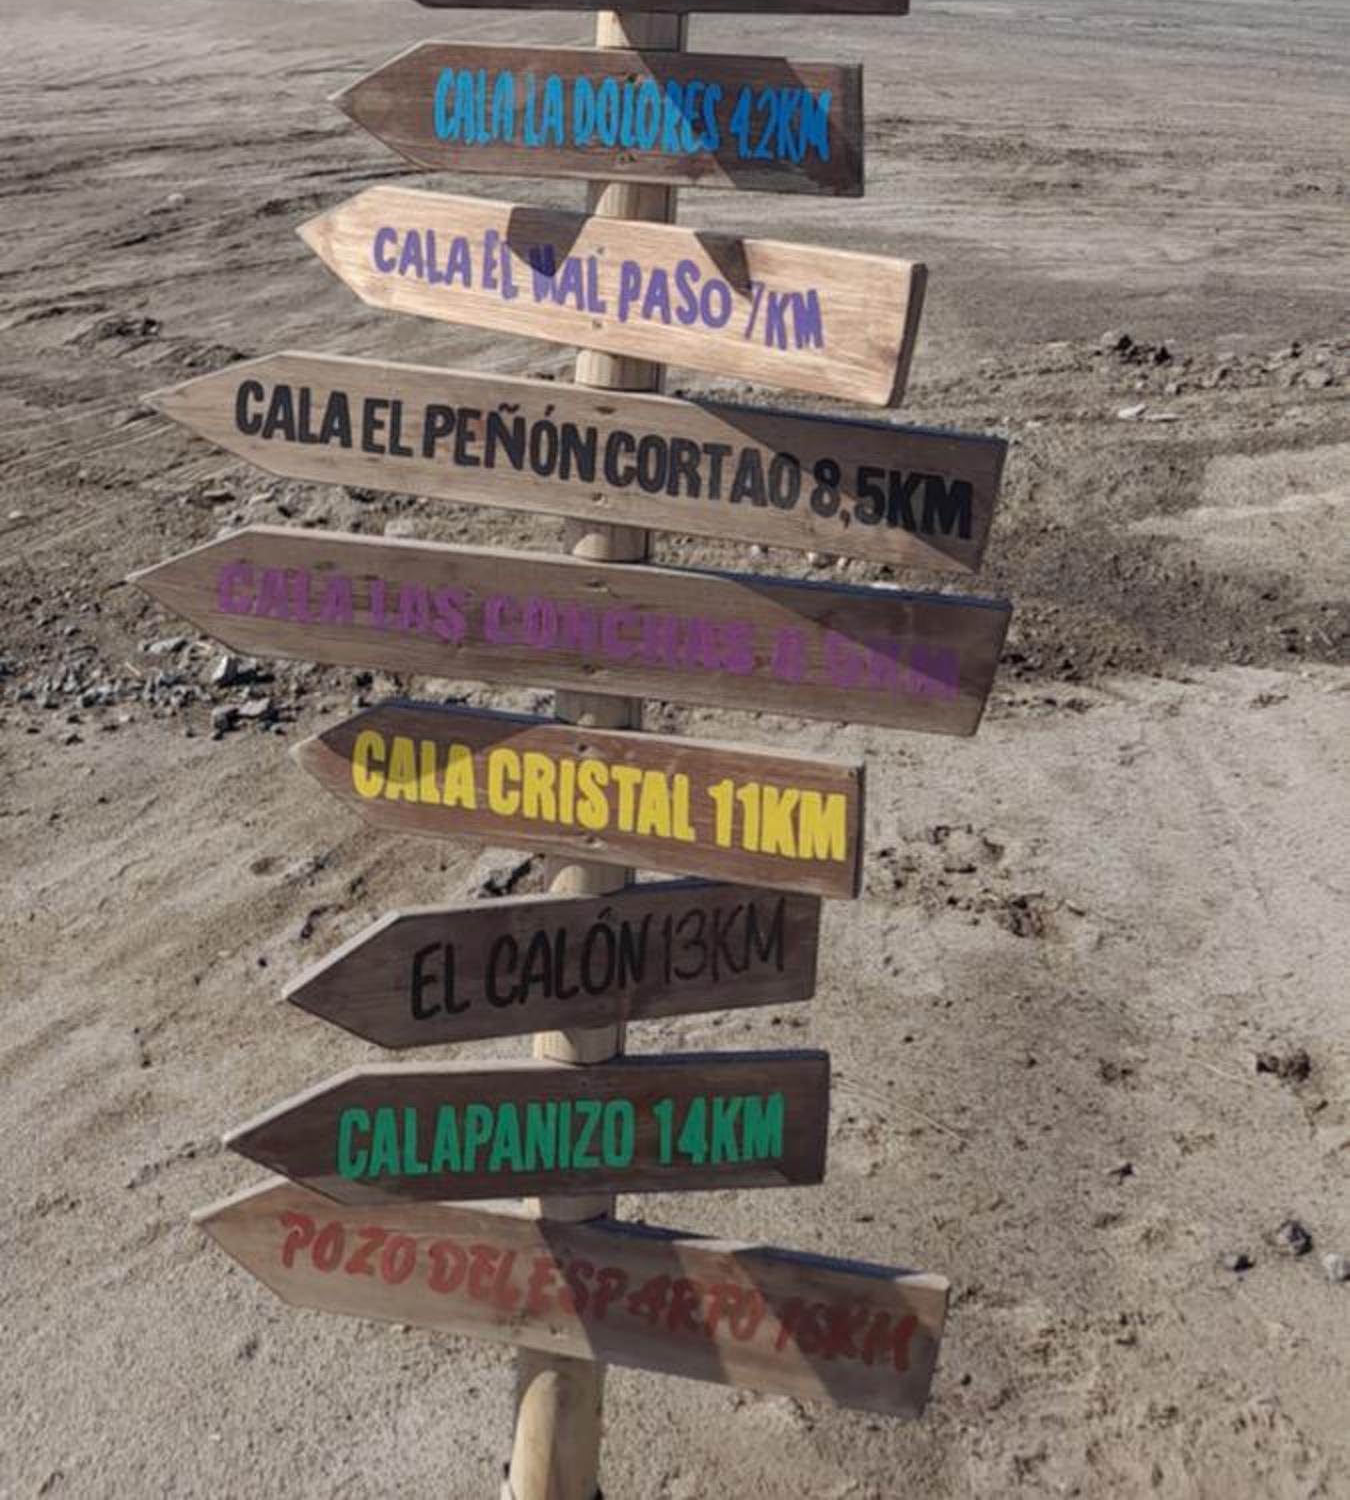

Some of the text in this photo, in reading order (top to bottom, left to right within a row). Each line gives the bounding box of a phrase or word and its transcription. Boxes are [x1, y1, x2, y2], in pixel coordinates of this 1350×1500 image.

[433, 67, 514, 145] CALA
[523, 71, 566, 150] LA
[573, 75, 722, 157] DOLORES
[373, 226, 472, 289] CALA
[482, 229, 518, 299] EL
[528, 244, 606, 314] MAL
[618, 260, 732, 348] PASO
[234, 379, 976, 541] CALA EL PEÑÓN CORTAO 8,5KM
[217, 561, 353, 628] CALA
[368, 579, 468, 645] LAS
[351, 729, 849, 863] CALA CRISTAL 11KM
[410, 897, 787, 1020] EL CALÓN 13KM
[652, 1092, 786, 1166] 14KM
[279, 1210, 418, 1285] POZO
[427, 1239, 521, 1312] DEL
